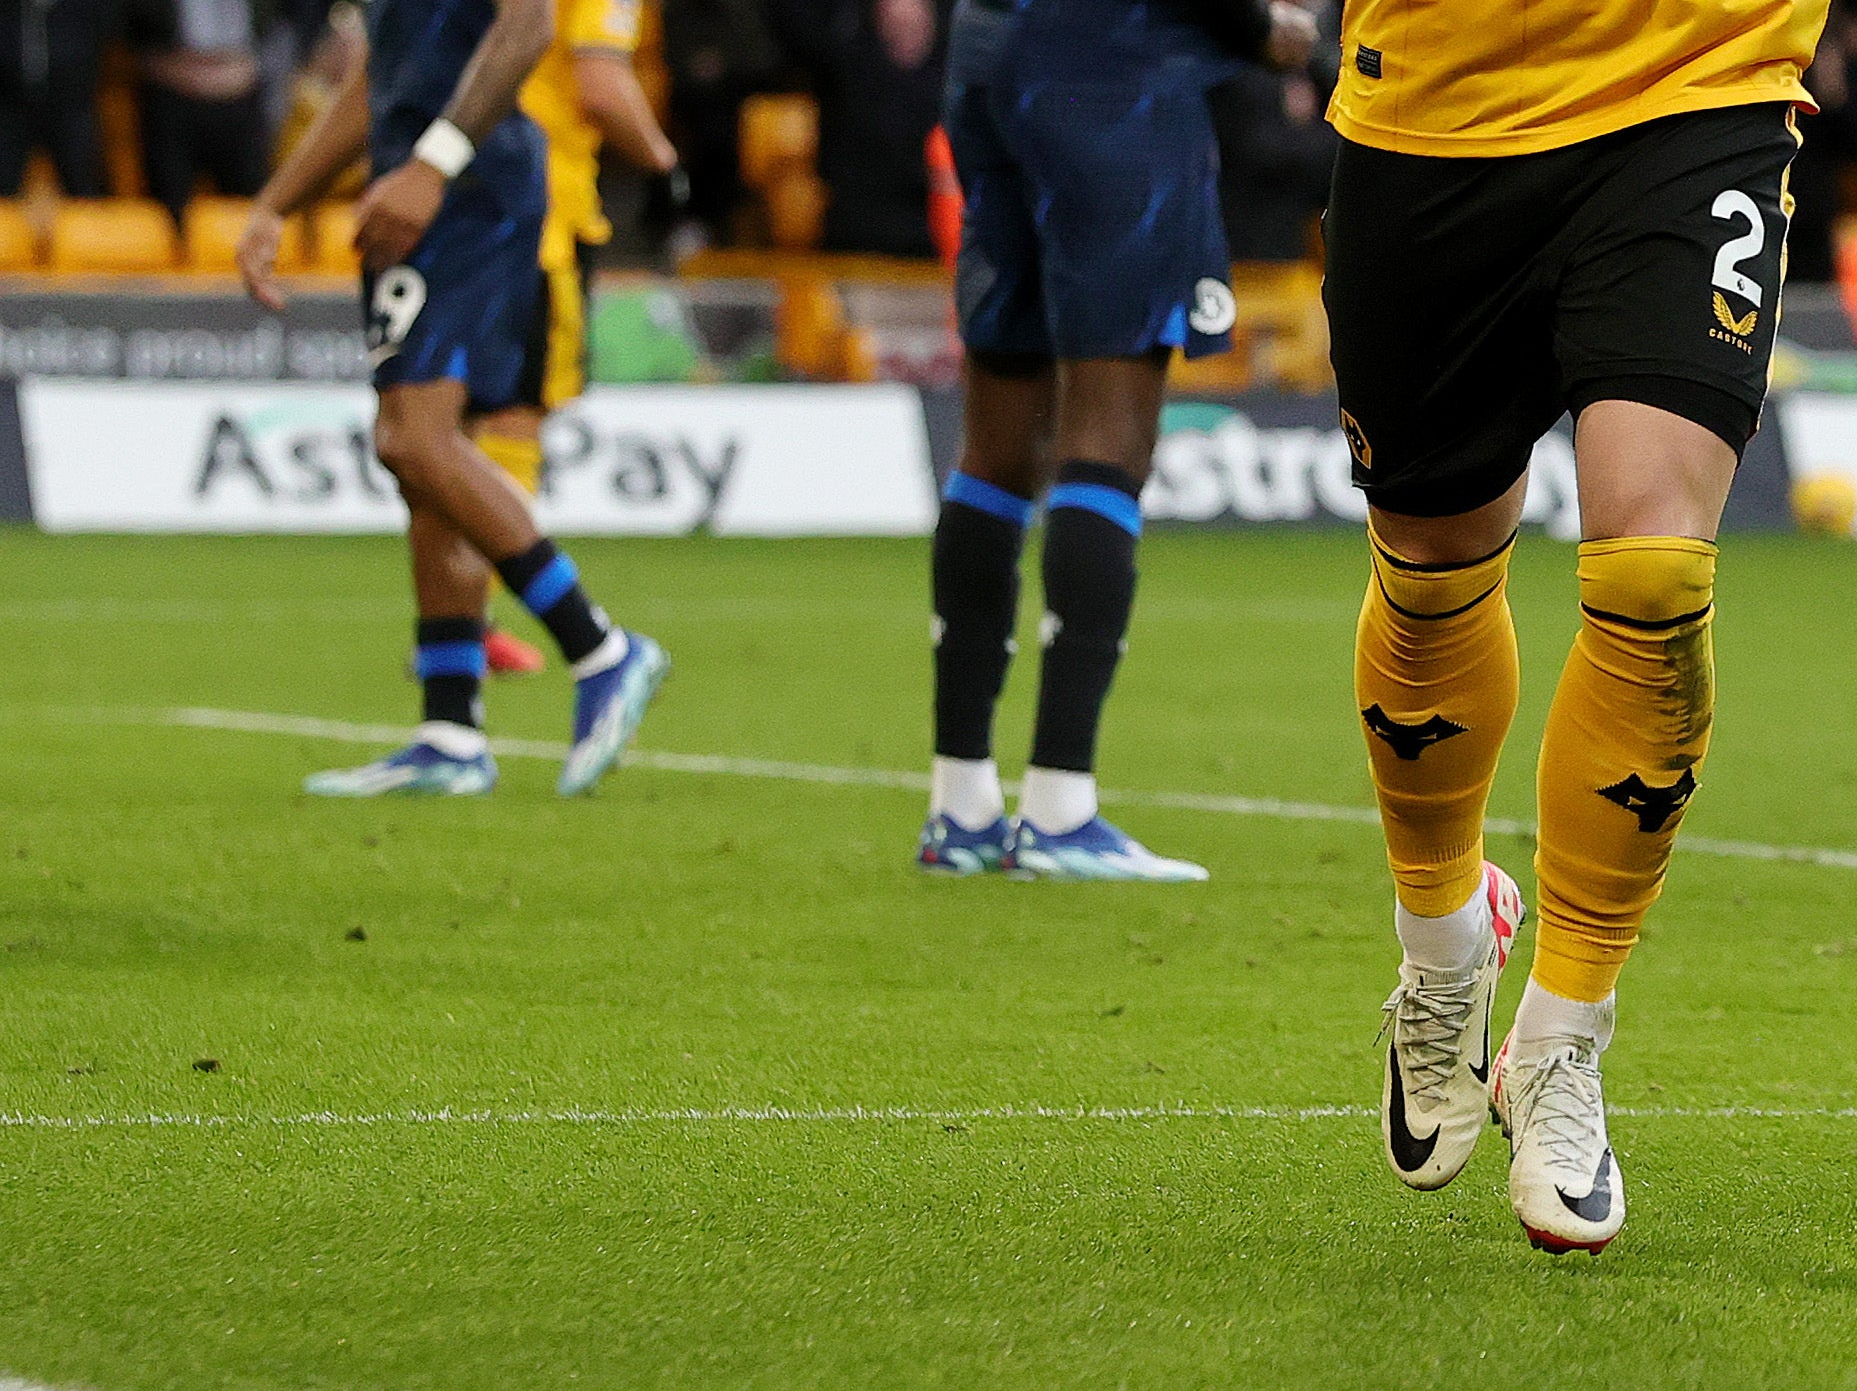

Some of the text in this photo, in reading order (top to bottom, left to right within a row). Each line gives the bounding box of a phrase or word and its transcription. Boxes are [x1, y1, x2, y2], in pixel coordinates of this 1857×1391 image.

[1711, 189, 1765, 309] 2
[1708, 327, 1753, 356] CASTORE
[197, 413, 741, 535] AstPay
